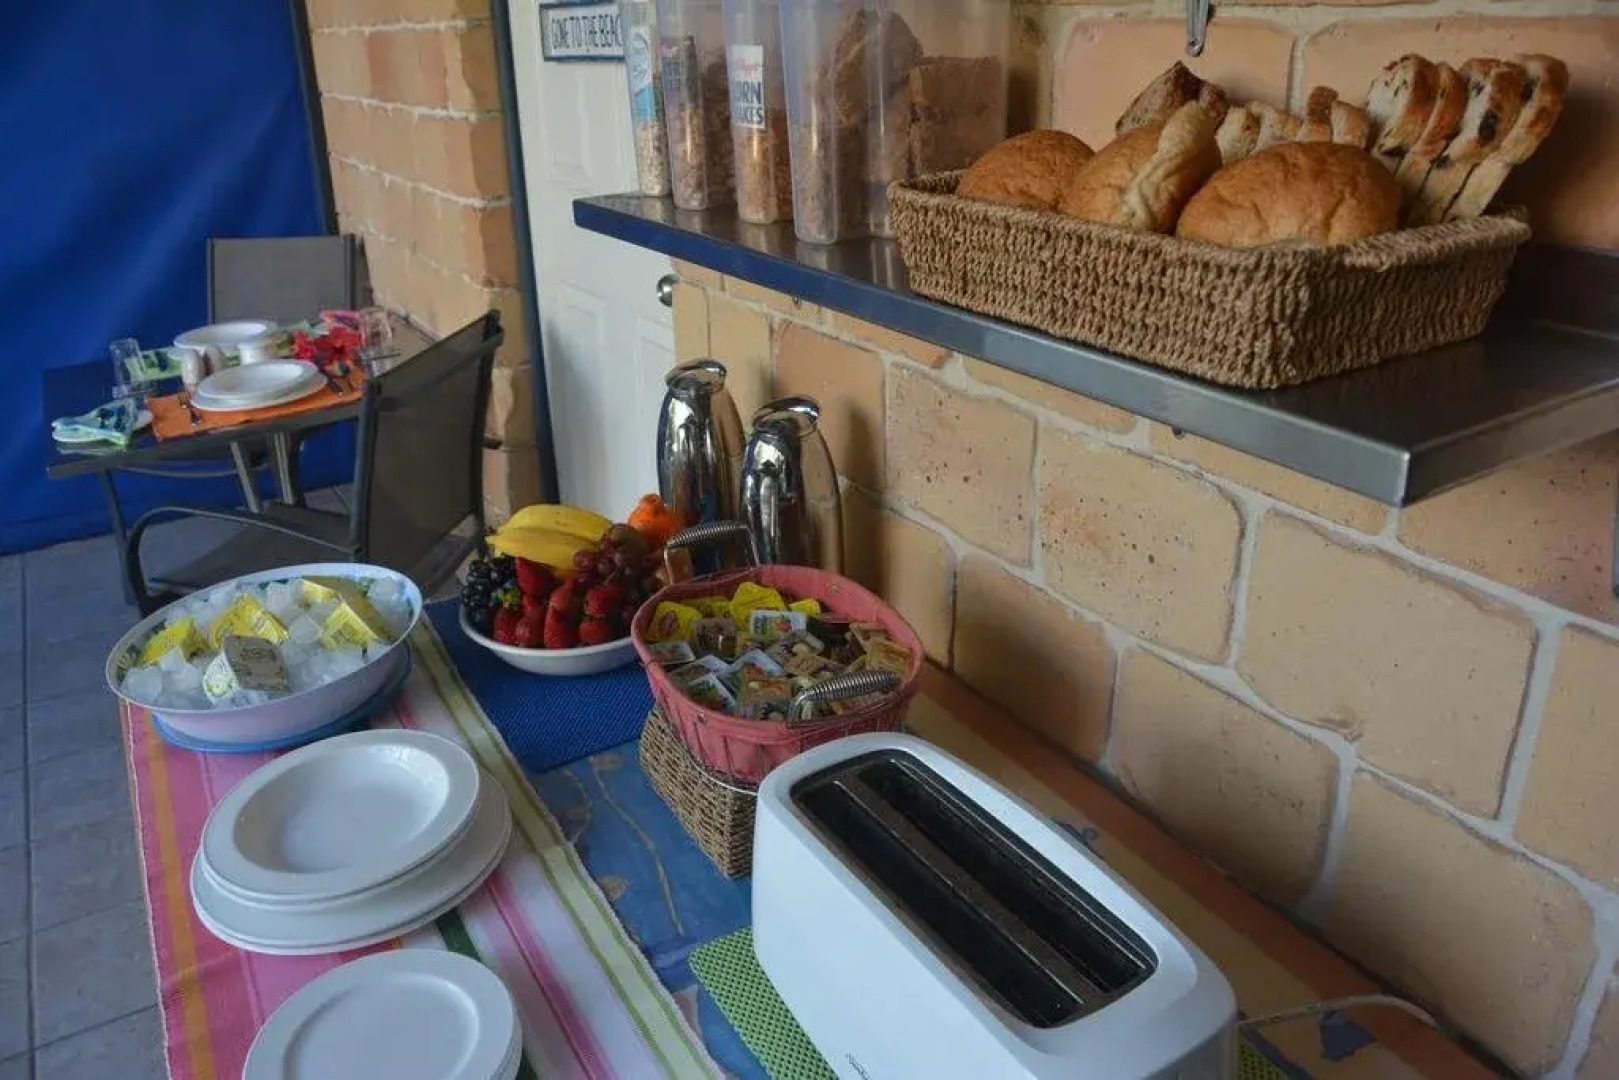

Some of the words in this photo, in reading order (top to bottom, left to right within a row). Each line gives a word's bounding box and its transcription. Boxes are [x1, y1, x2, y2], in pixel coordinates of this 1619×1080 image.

[551, 18, 569, 49] GONE
[569, 16, 582, 48] TO
[582, 15, 598, 48] THE
[599, 13, 623, 48] BEAC
